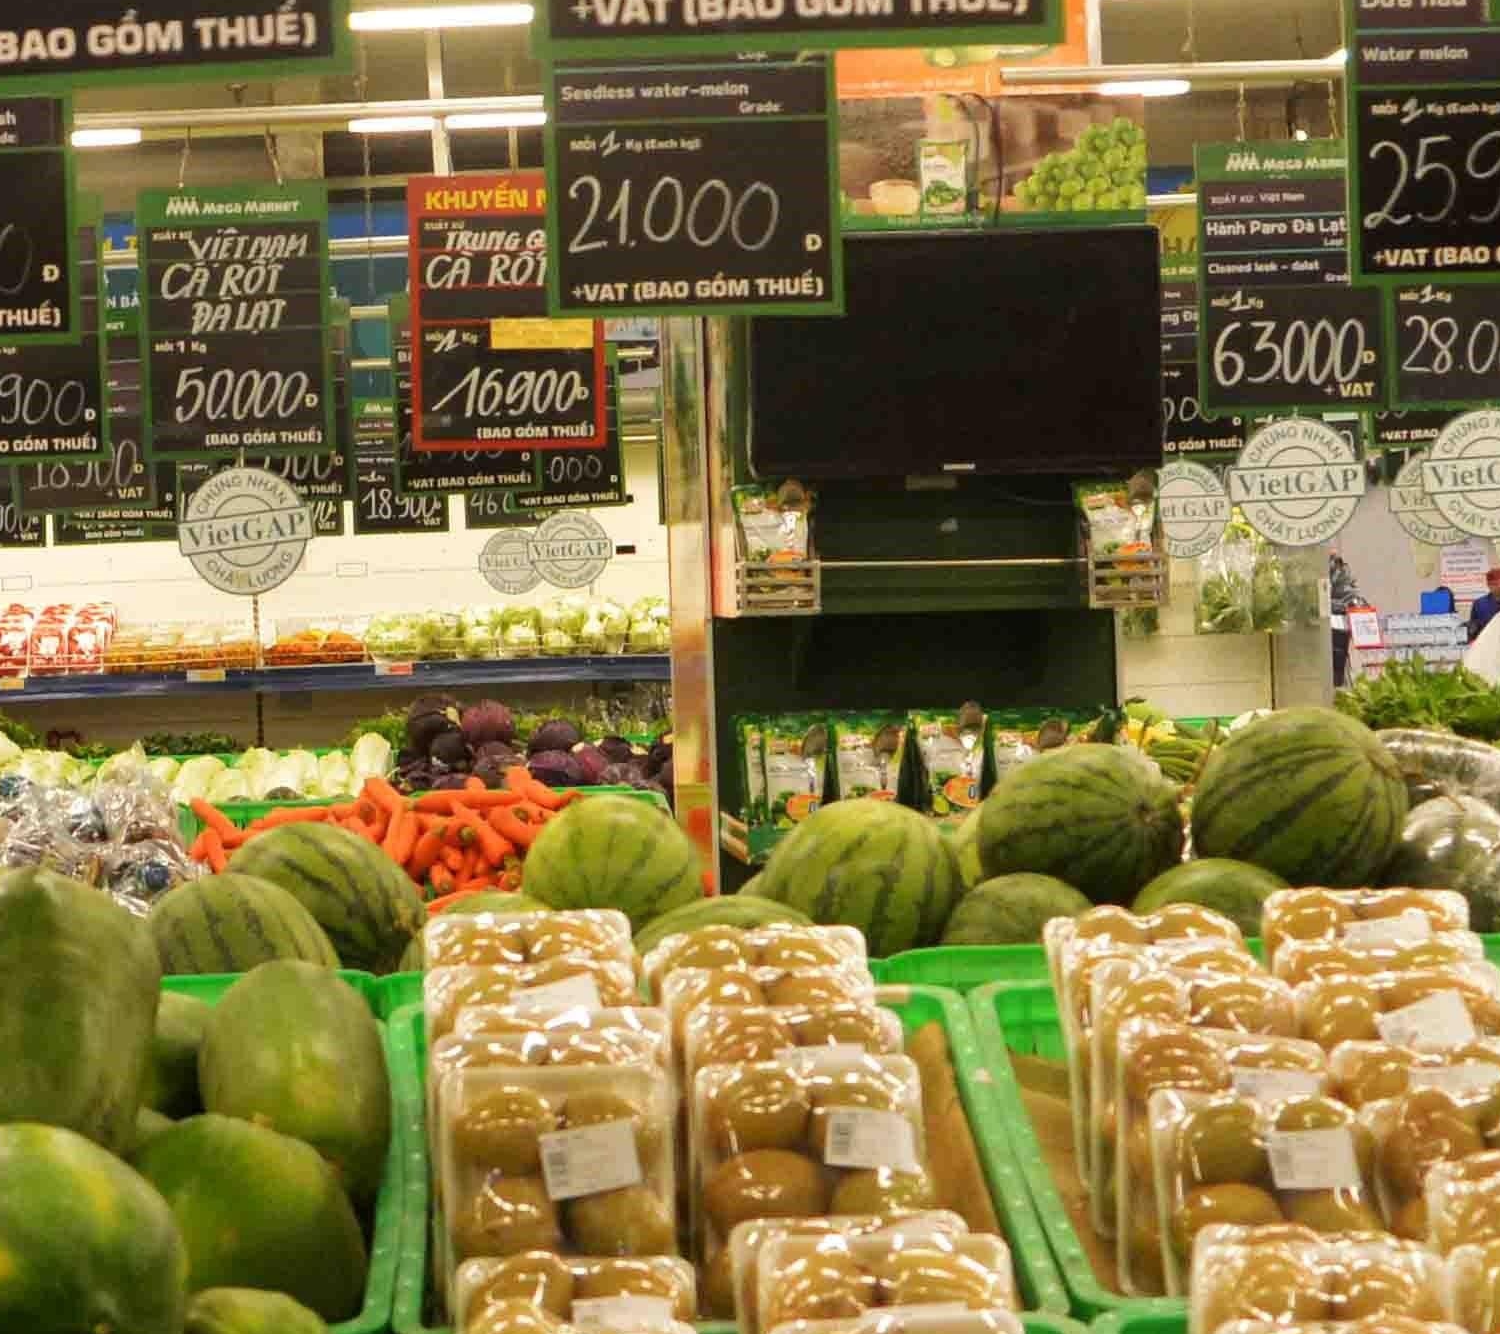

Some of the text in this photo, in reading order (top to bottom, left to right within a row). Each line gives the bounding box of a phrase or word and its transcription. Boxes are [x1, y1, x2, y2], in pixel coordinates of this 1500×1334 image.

[1363, 46, 1468, 61] Water melon
[562, 84, 634, 101] Seedless
[567, 175, 780, 254] 21.000
[1249, 220, 1287, 235] Paro
[175, 368, 309, 422] 50.000
